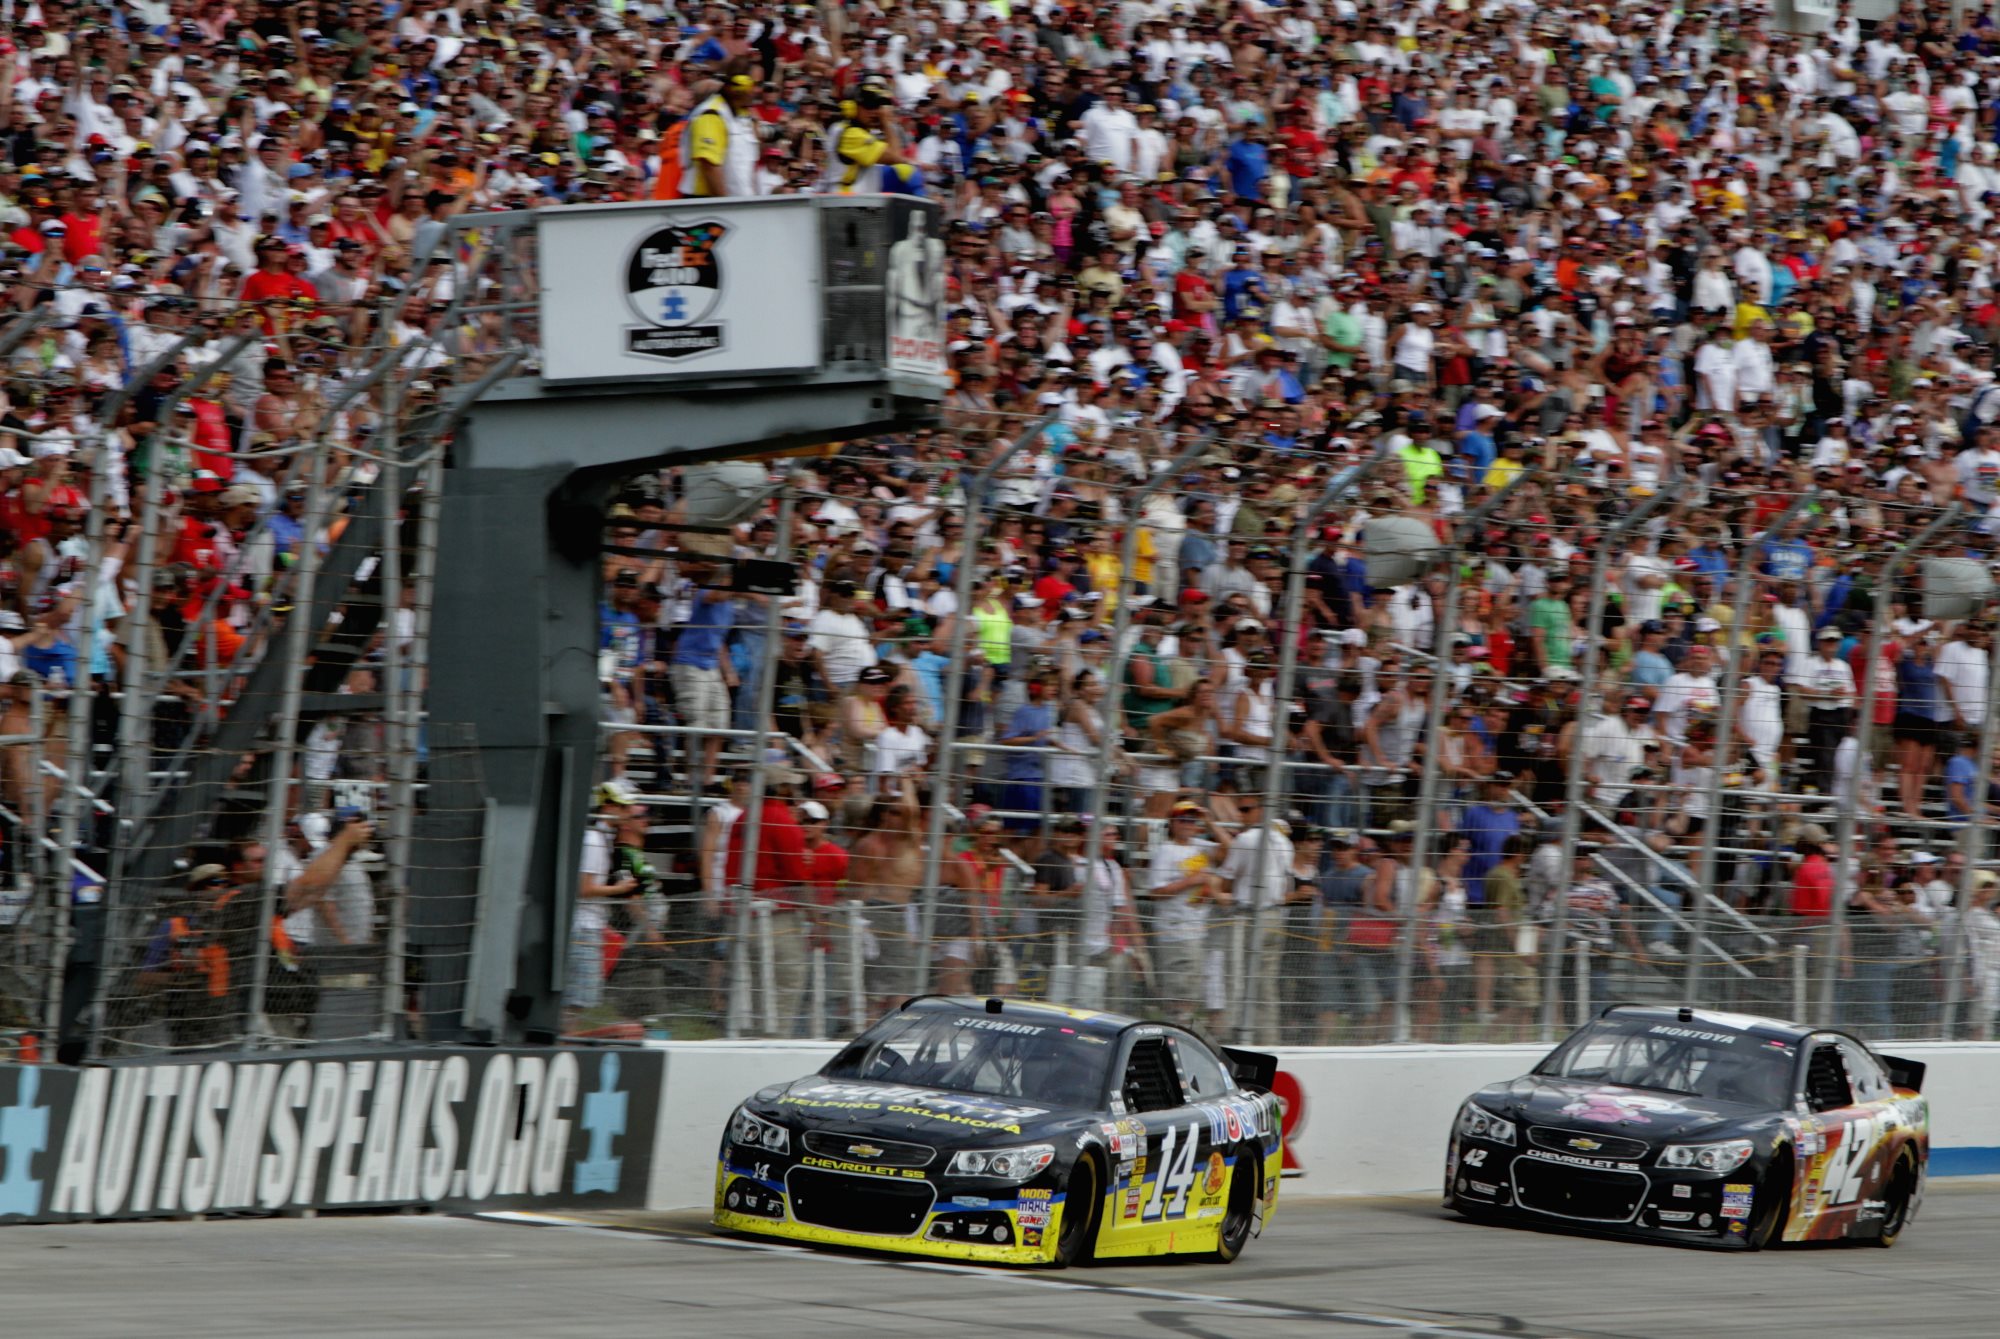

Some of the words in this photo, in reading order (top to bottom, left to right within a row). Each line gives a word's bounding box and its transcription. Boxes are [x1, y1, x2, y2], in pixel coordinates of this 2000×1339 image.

[641, 246, 708, 268] FedEx
[648, 267, 700, 285] 400
[953, 1017, 1046, 1036] STEWART
[1648, 1026, 1736, 1044] MONTOYA
[778, 1098, 881, 1110] HELPING
[887, 1105, 1021, 1135] OKLAHOMA
[802, 1156, 898, 1177] CHEVROLET
[902, 1168, 926, 1179] SS
[1463, 1149, 1488, 1167] 42
[1527, 1149, 1614, 1169] CHEVROLET
[1617, 1162, 1639, 1171] SS
[1822, 1118, 1873, 1205] 42
[752, 1162, 770, 1181] 14
[1142, 1122, 1200, 1224] 14
[1018, 1189, 1053, 1200] MOOG
[1018, 1201, 1051, 1212] MAHLE
